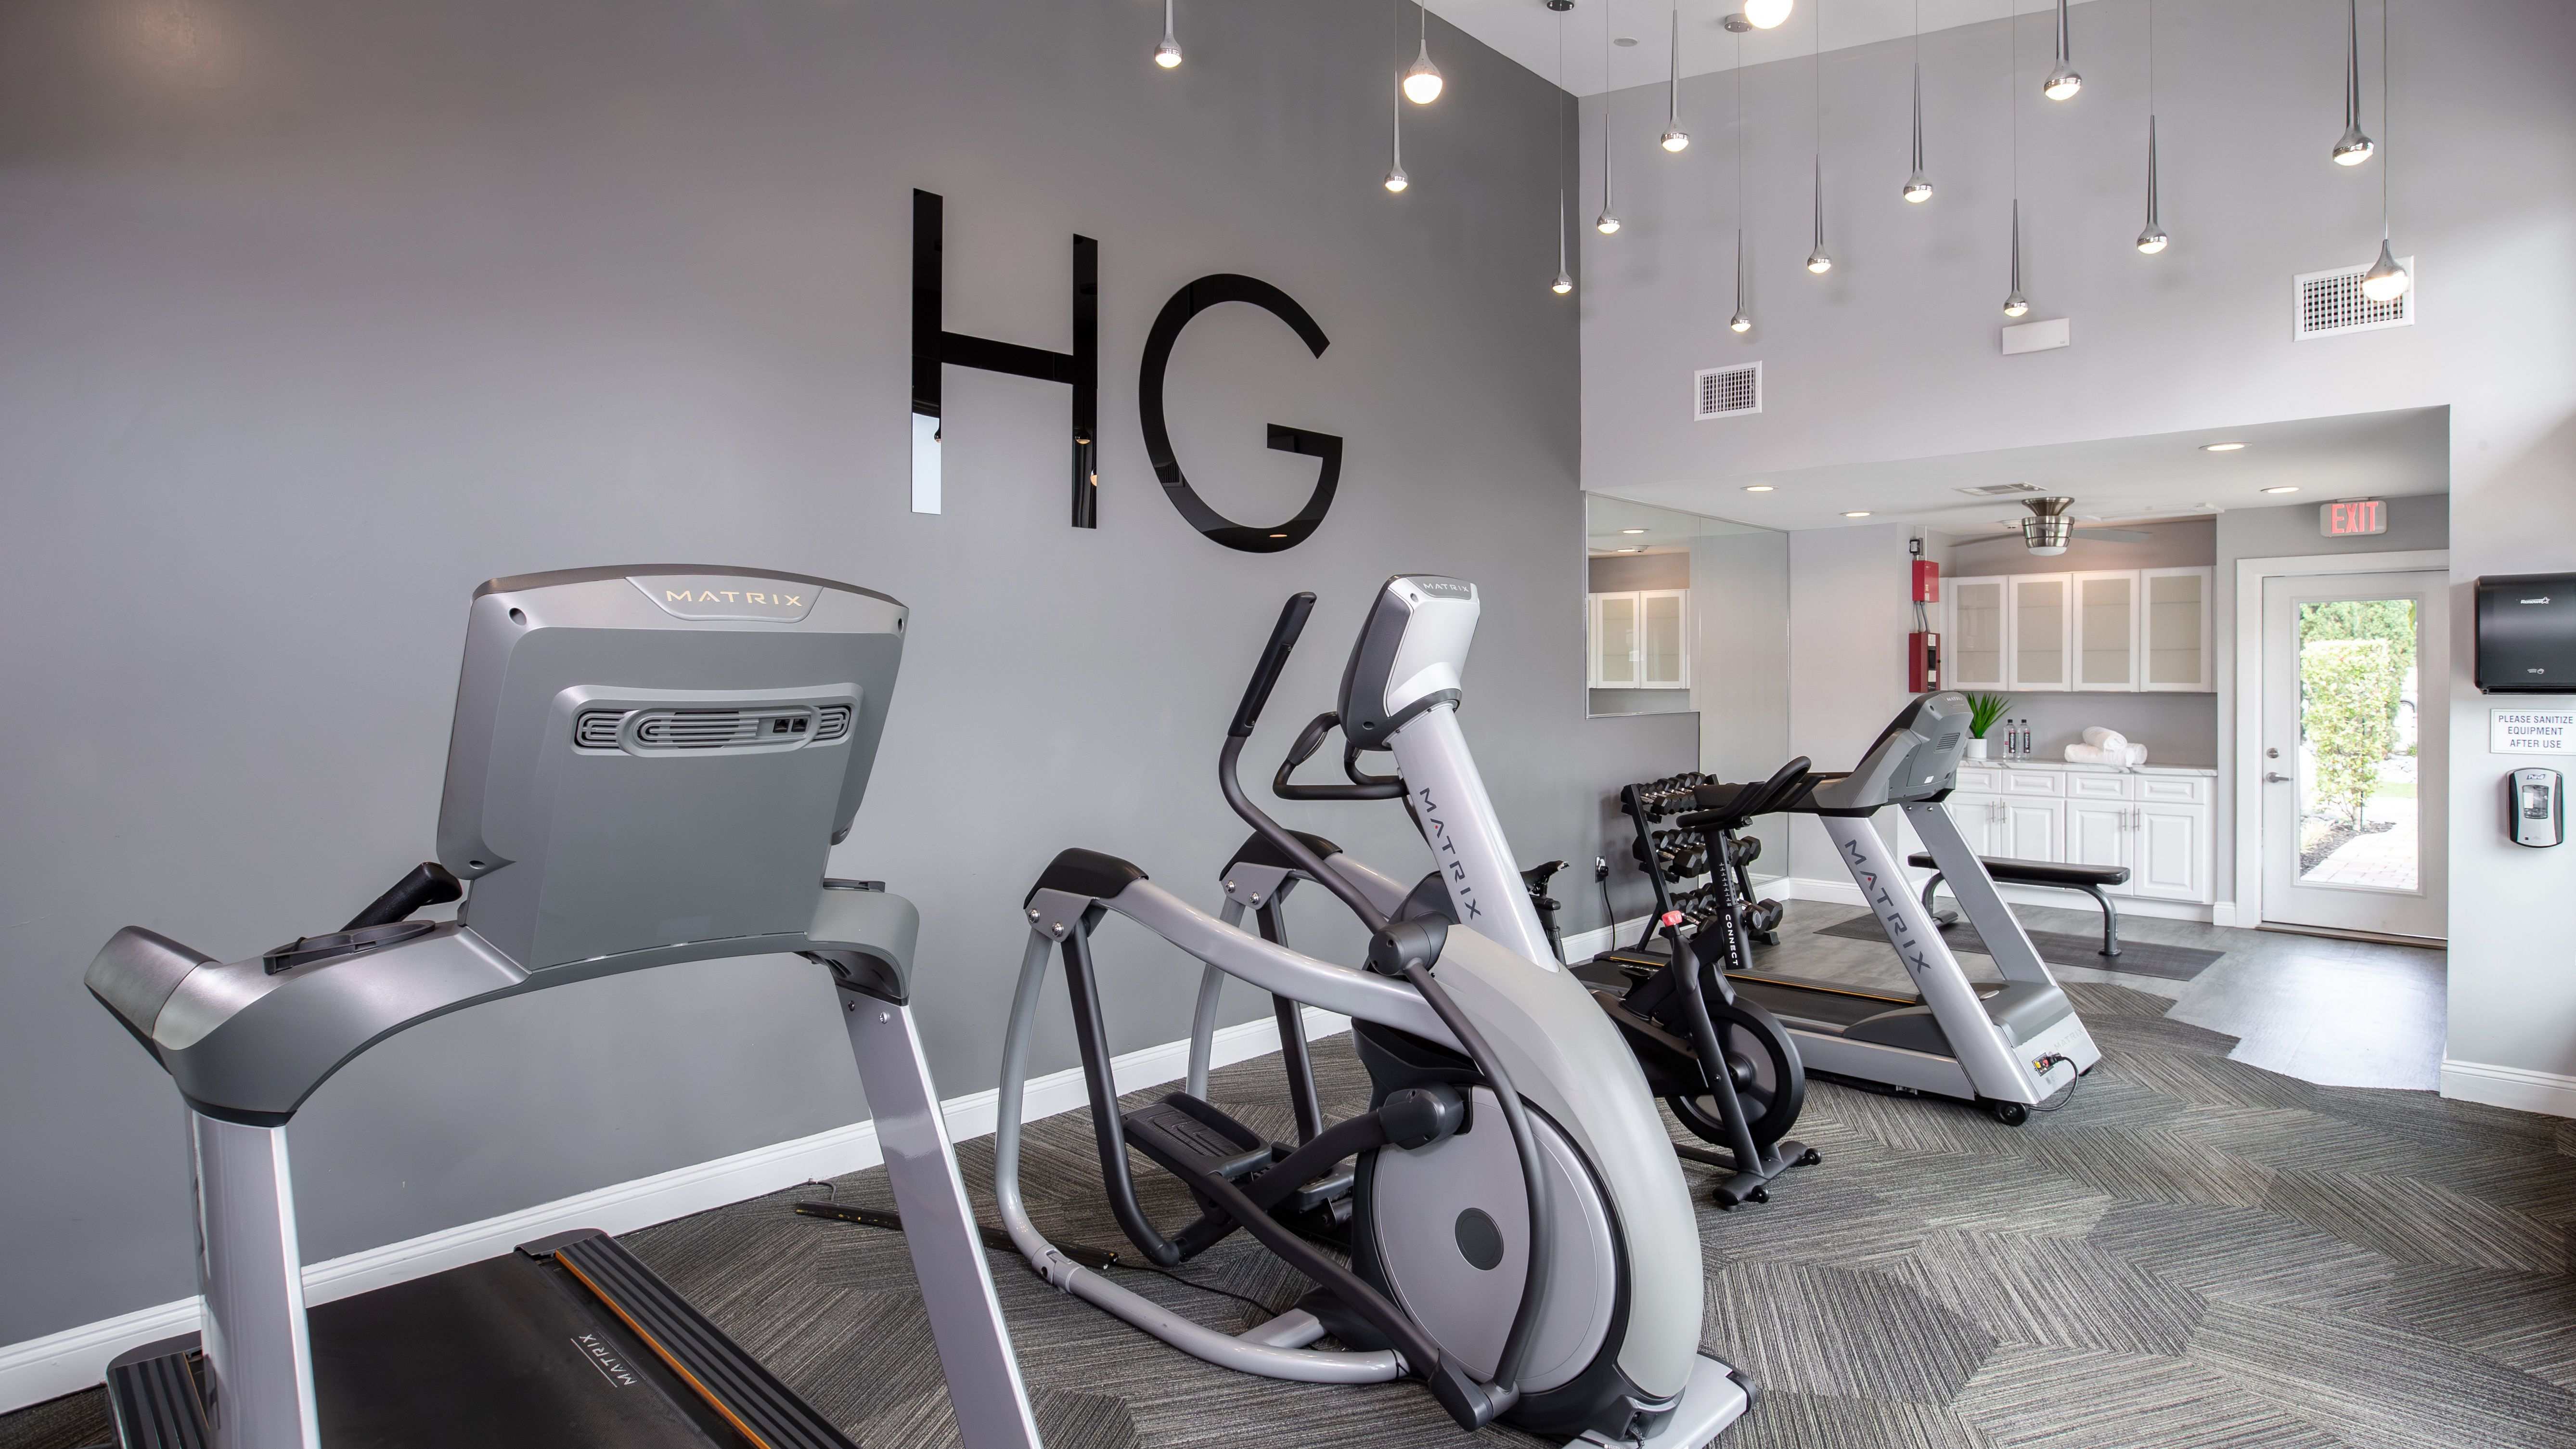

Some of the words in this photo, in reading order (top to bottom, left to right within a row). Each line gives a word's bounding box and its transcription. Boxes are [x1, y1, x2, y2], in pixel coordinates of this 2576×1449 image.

[911, 188, 1343, 554] HG
[2331, 501, 2379, 534] EXIT
[666, 590, 803, 607] MATRIX
[1423, 583, 1469, 592] MATRIX
[2508, 726, 2563, 735] EQUIPMENT
[2534, 716, 2573, 724] SANITIZE
[2510, 739, 2539, 748] AFTER
[2543, 740, 2561, 748] USE
[1419, 788, 1481, 920] MATRIX
[1844, 839, 1931, 974] MATRIX
[1726, 914, 1739, 966] CONNECT
[579, 1333, 637, 1385] MATRIX
